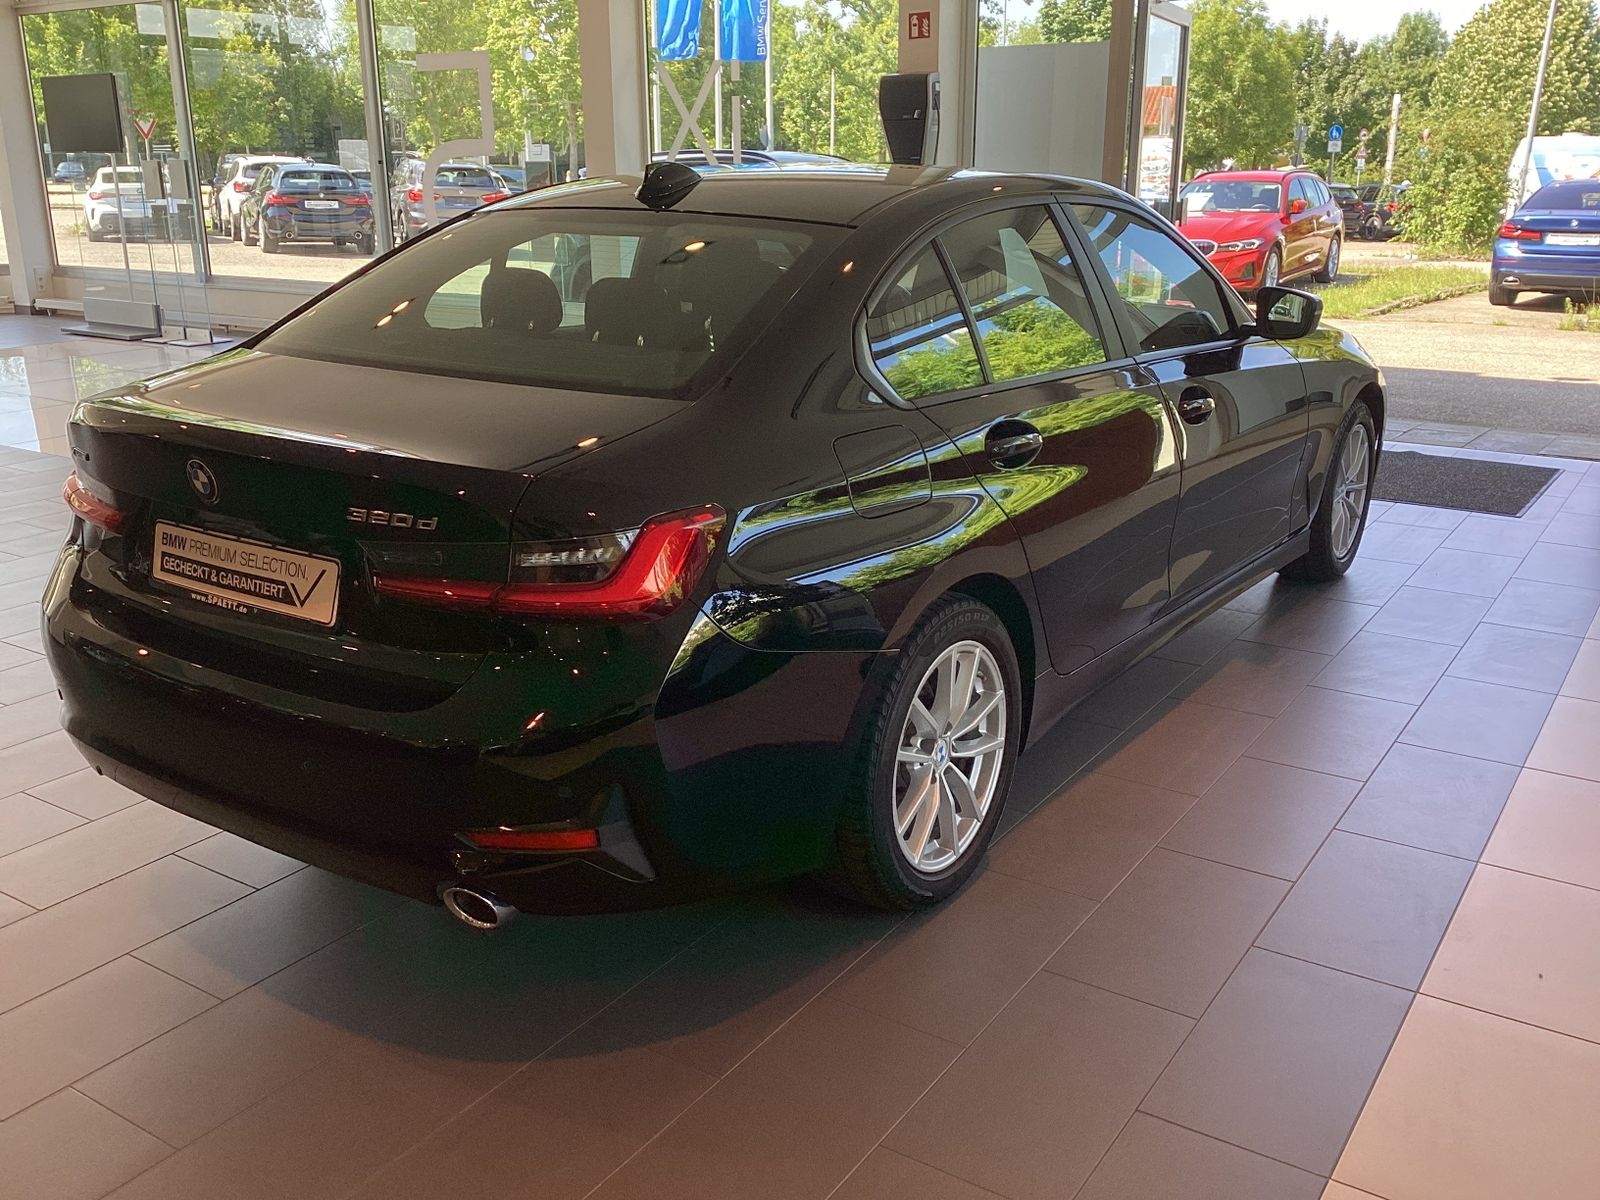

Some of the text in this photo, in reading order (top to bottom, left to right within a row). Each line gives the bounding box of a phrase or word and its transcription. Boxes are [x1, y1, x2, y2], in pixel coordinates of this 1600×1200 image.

[757, 26, 766, 55] BMW
[162, 531, 309, 581] BMW PREMIUM SELECTION.
[163, 556, 286, 599] GECHECKT & GARANTIERT
